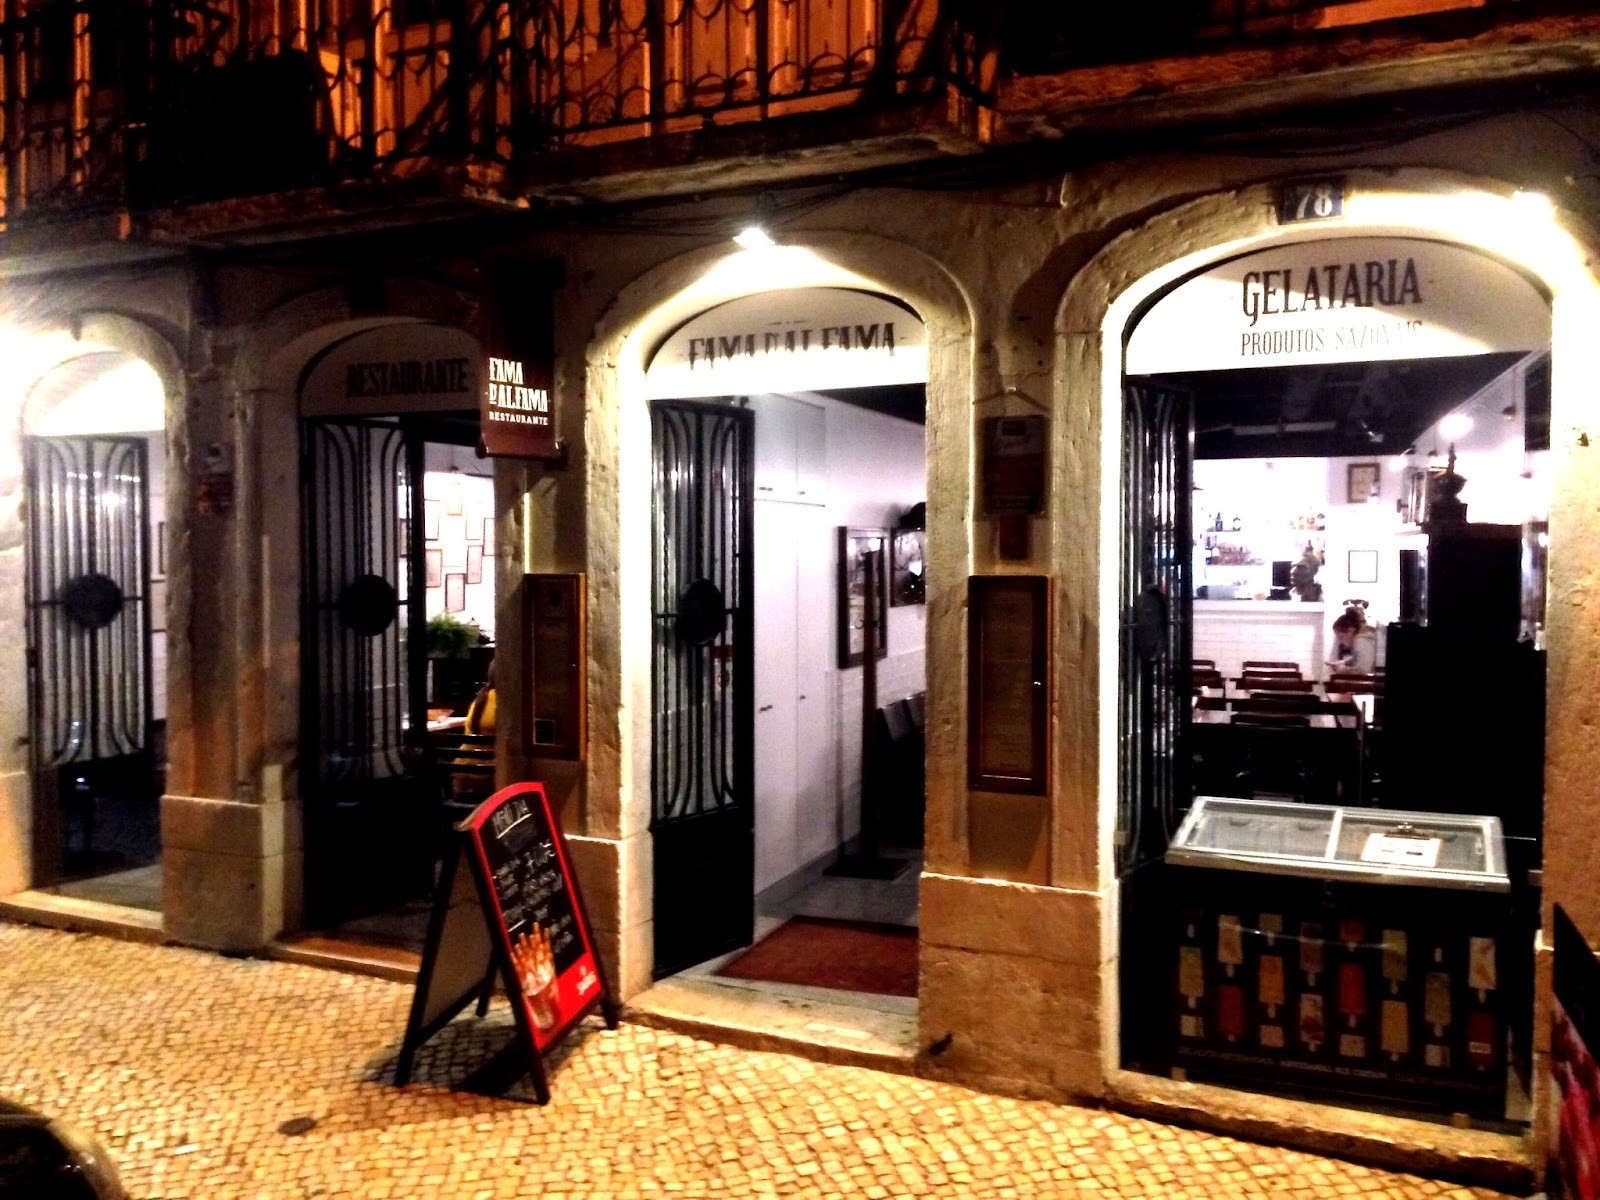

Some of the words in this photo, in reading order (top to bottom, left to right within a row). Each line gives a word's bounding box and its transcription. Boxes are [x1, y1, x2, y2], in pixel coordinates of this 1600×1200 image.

[1294, 185, 1333, 220] 78
[1242, 257, 1423, 327] GELATARIA
[688, 333, 756, 370] FAMA
[1241, 326, 1326, 356] PRODUTOS
[346, 358, 469, 398] RESTAURANTE
[488, 357, 524, 385] FAMA
[488, 411, 549, 426] RESTAURANTE
